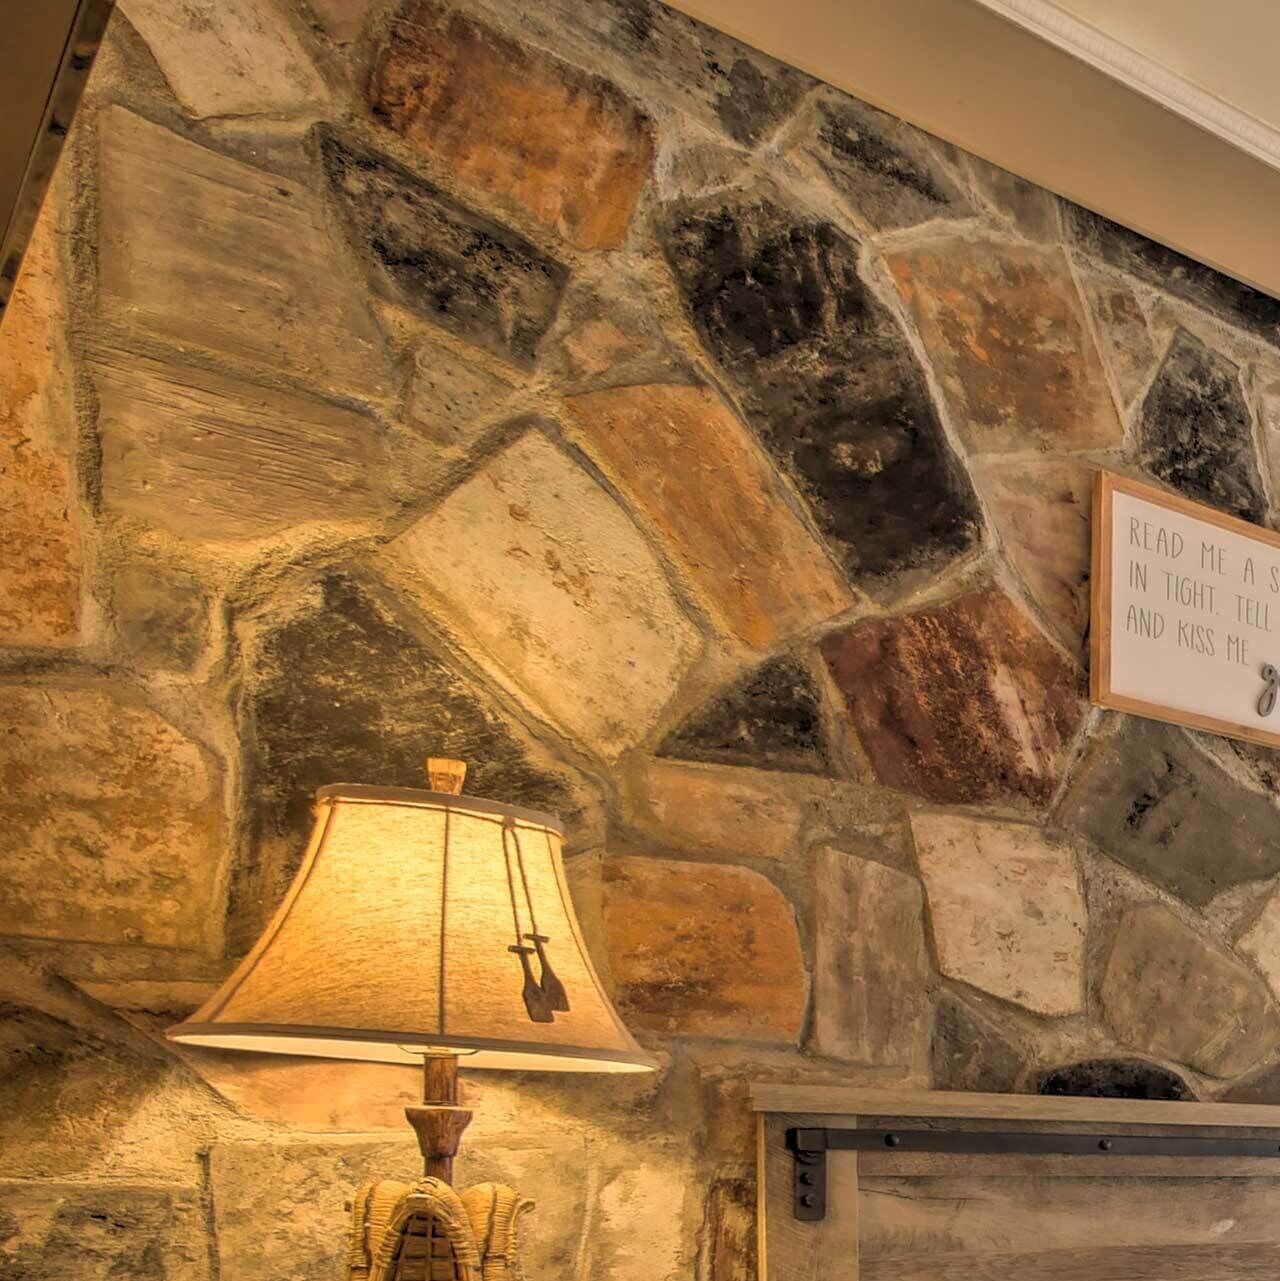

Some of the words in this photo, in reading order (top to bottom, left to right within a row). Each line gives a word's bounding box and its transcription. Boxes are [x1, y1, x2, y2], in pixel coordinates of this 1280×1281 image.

[1129, 517, 1184, 559] READ
[1201, 541, 1227, 576] ME
[1243, 558, 1256, 585] A
[1129, 560, 1148, 592] IN
[1161, 572, 1220, 616] TIGHT.
[1234, 593, 1272, 632] TELL
[1126, 604, 1165, 639] AND
[1177, 621, 1216, 656] KISS
[1226, 635, 1250, 666] ME
